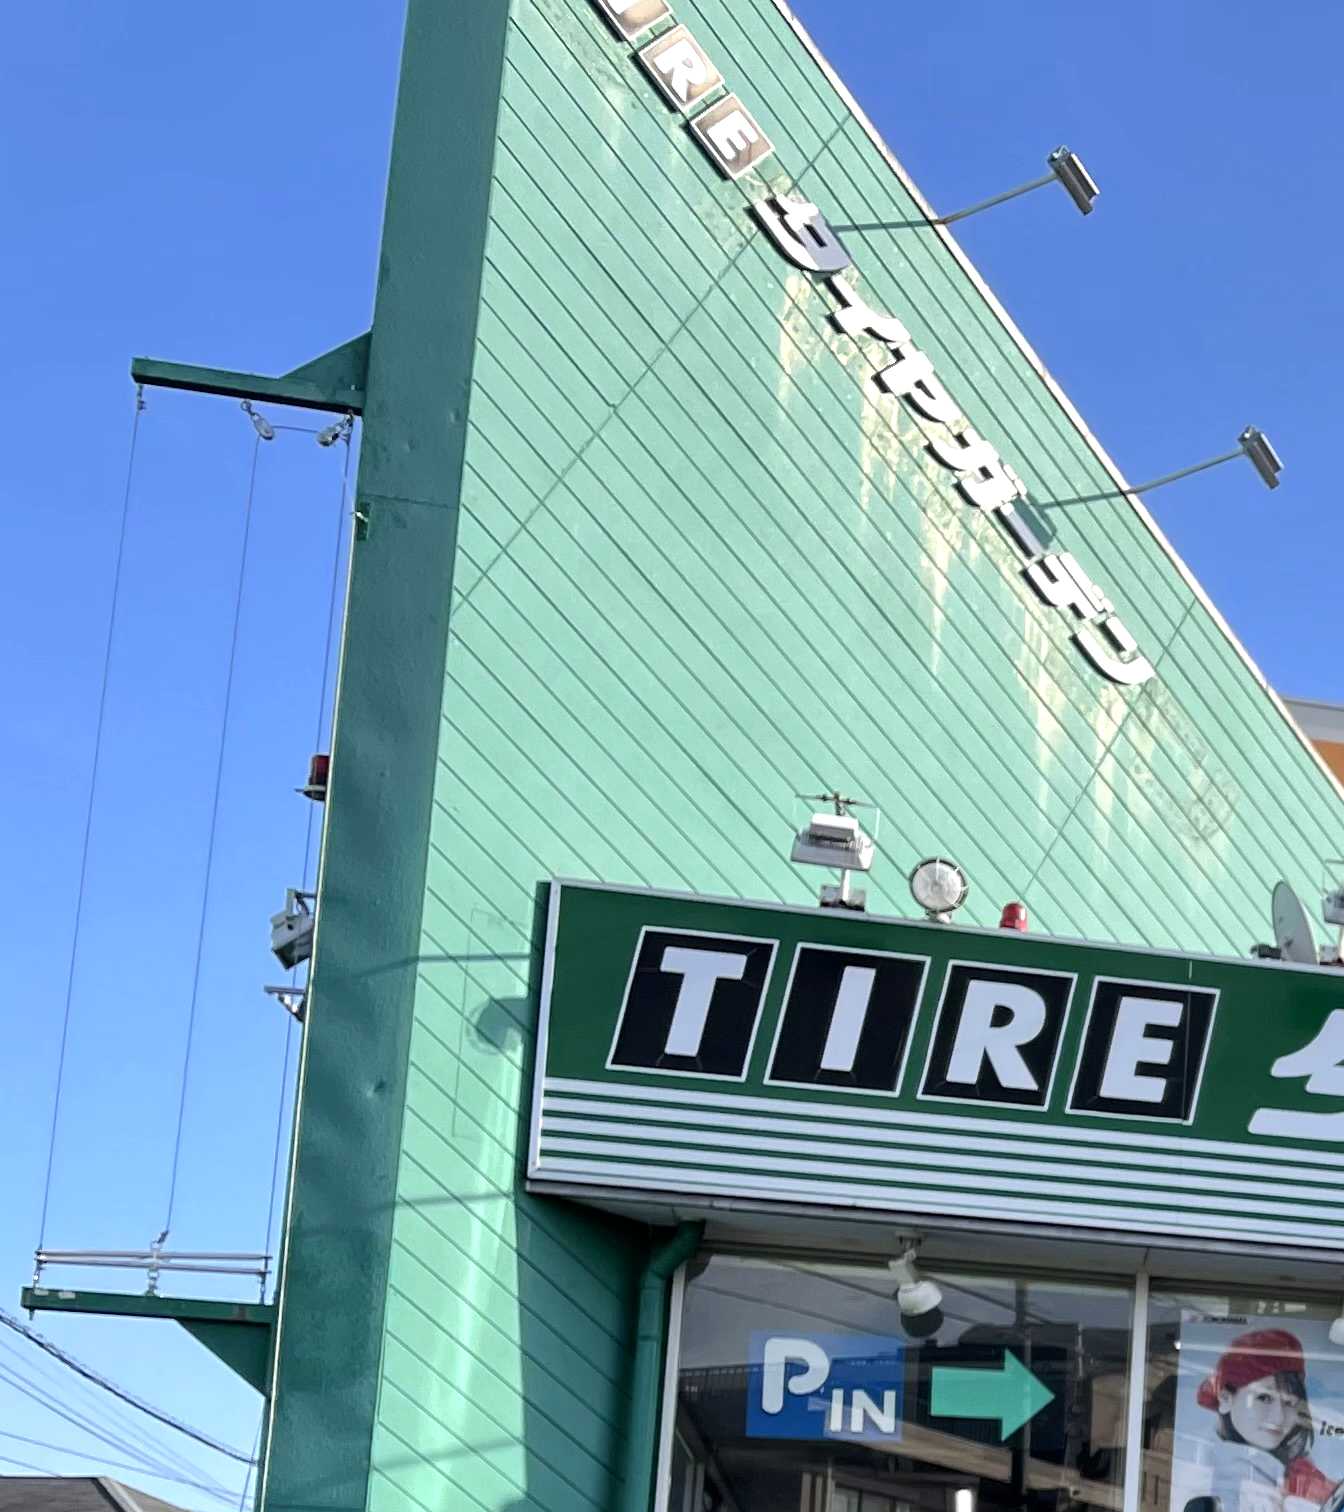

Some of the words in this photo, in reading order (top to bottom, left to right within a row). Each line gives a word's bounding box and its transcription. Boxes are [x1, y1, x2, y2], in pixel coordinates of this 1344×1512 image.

[606, 0, 759, 161] RE
[755, 194, 1156, 686] タイヤガーデン
[660, 946, 1183, 1104] TIRE
[830, 1388, 897, 1433] IN
